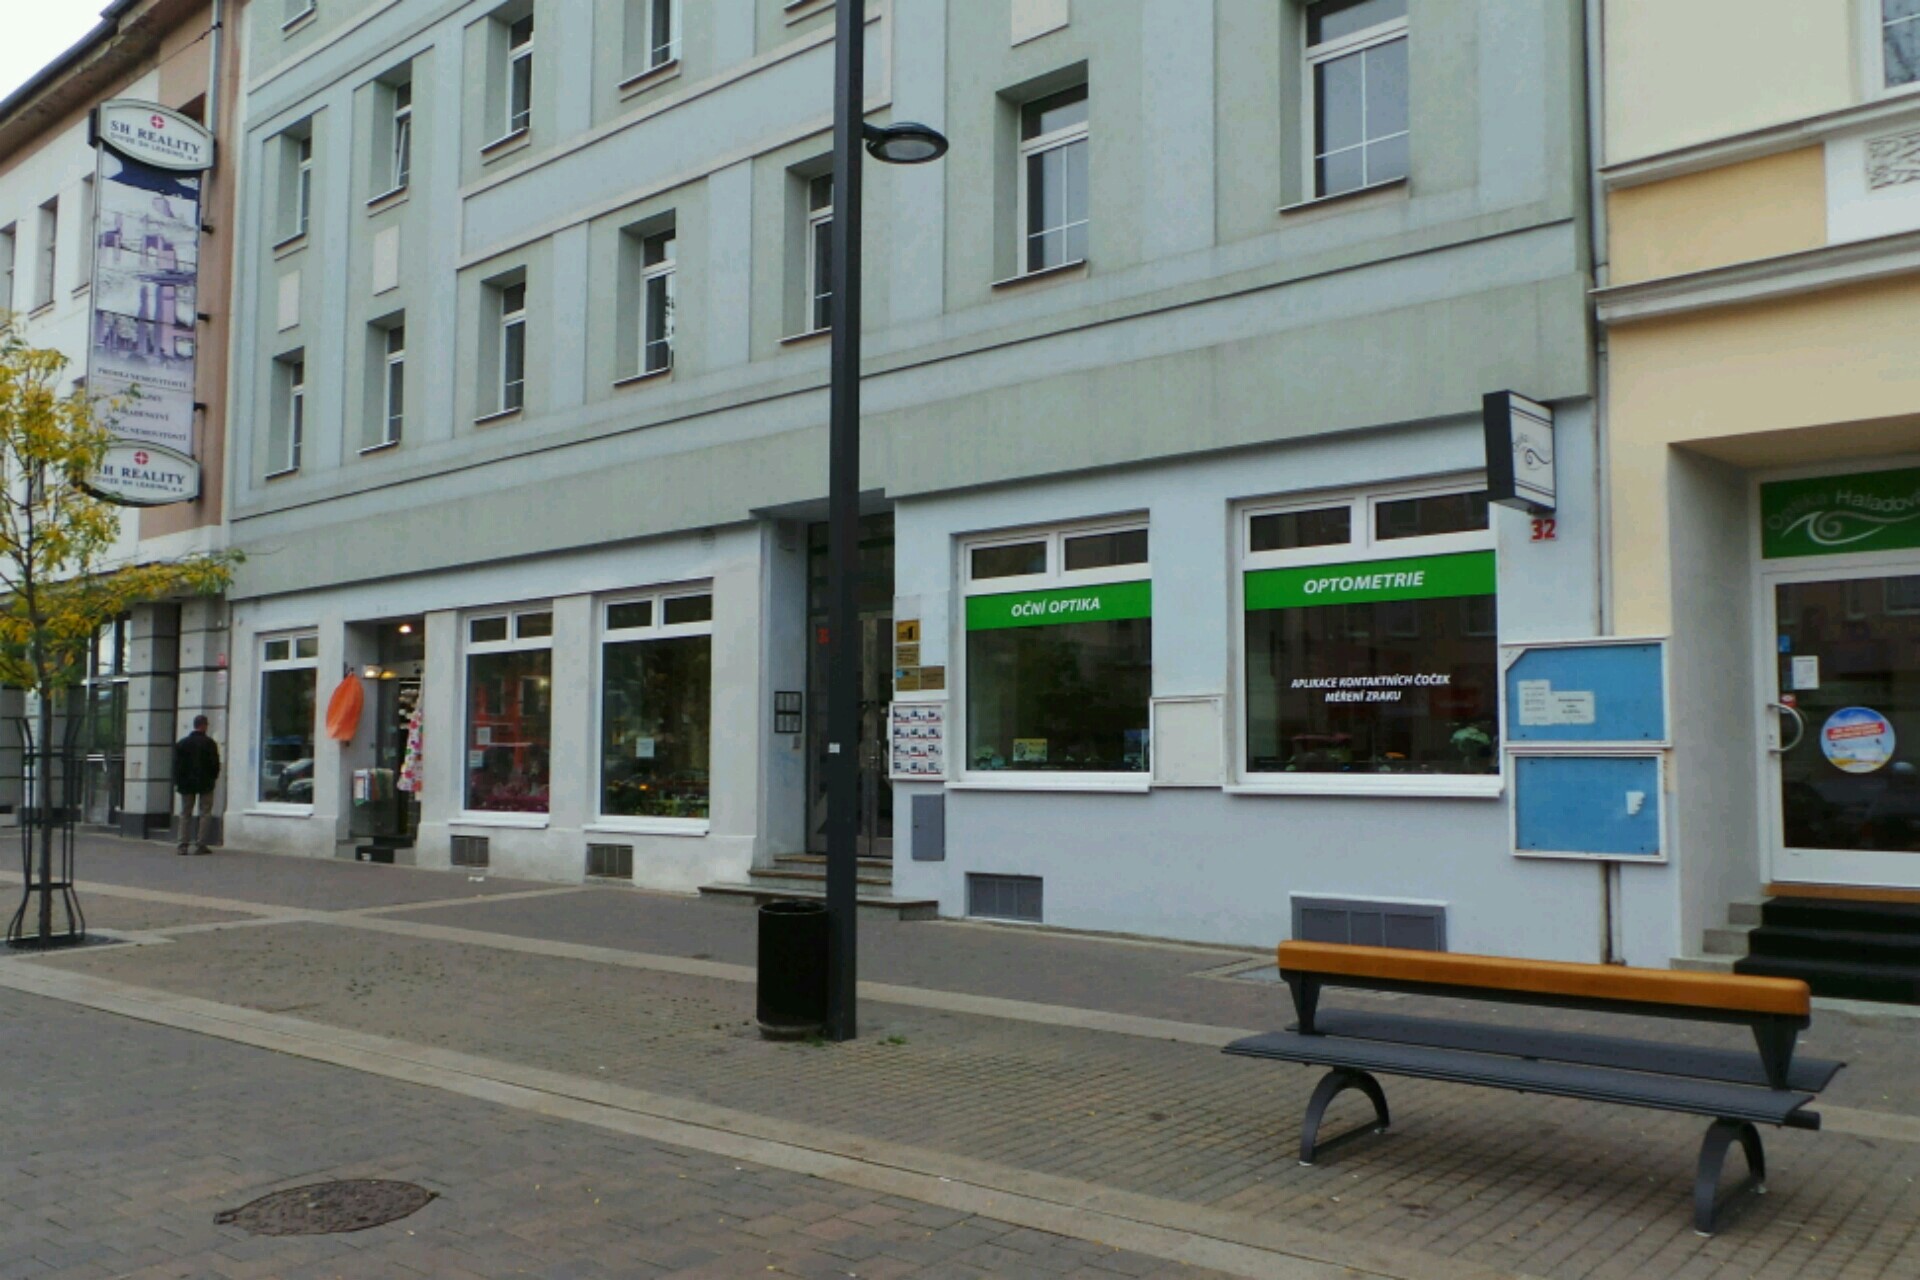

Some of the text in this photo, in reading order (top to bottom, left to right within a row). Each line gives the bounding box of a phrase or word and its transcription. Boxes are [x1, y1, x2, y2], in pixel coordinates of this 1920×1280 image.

[110, 120, 201, 154] SH REALITY
[121, 467, 185, 485] REALITY
[1531, 519, 1556, 540] 32
[1303, 571, 1425, 594] OPTOMETRIE
[1011, 597, 1101, 617] OČNÍ OPTIKA
[1291, 673, 1450, 688] APLIKACE KONTAKTNÍCH ČOČEK
[1325, 689, 1402, 702] MĚŘENÍ ZRAKU
